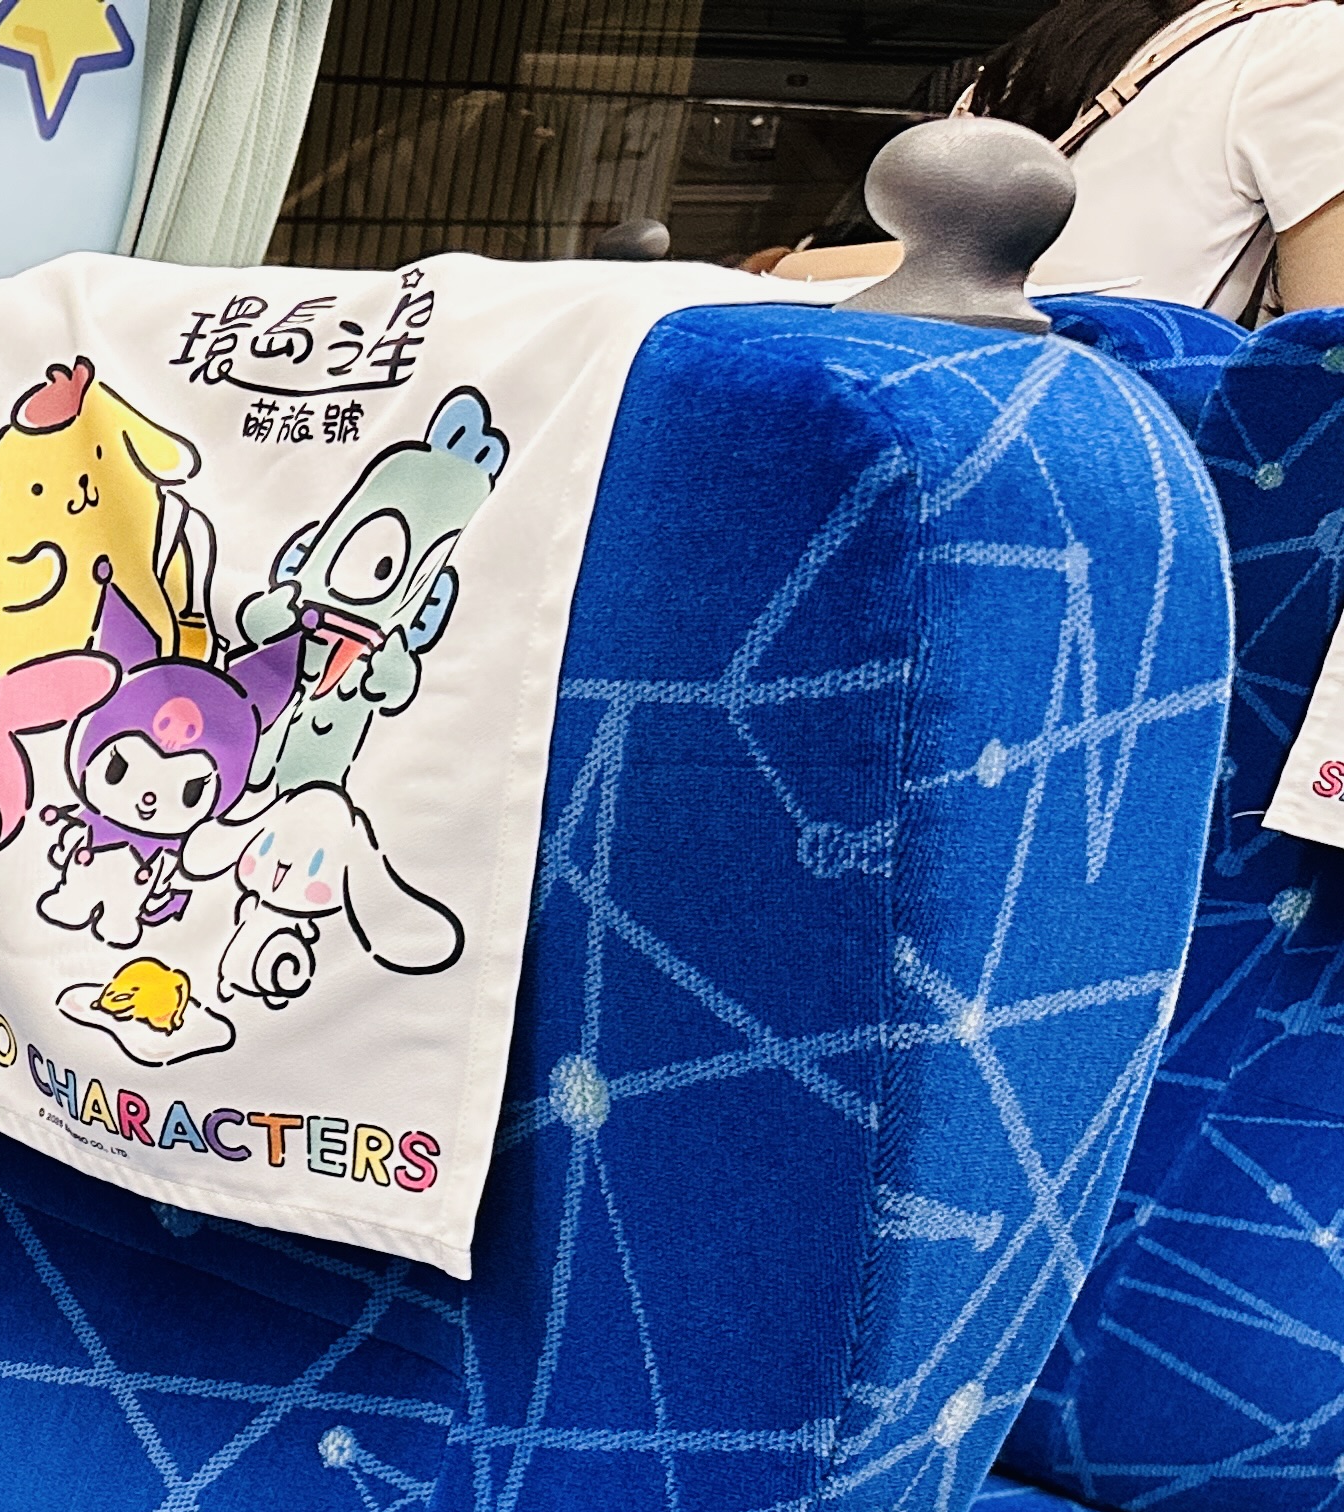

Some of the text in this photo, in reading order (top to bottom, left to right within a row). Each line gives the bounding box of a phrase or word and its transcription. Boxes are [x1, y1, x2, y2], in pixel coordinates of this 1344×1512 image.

[169, 268, 434, 397] 環島之星
[243, 398, 364, 443] 萌旅號
[27, 1042, 440, 1192] CHARACTERS
